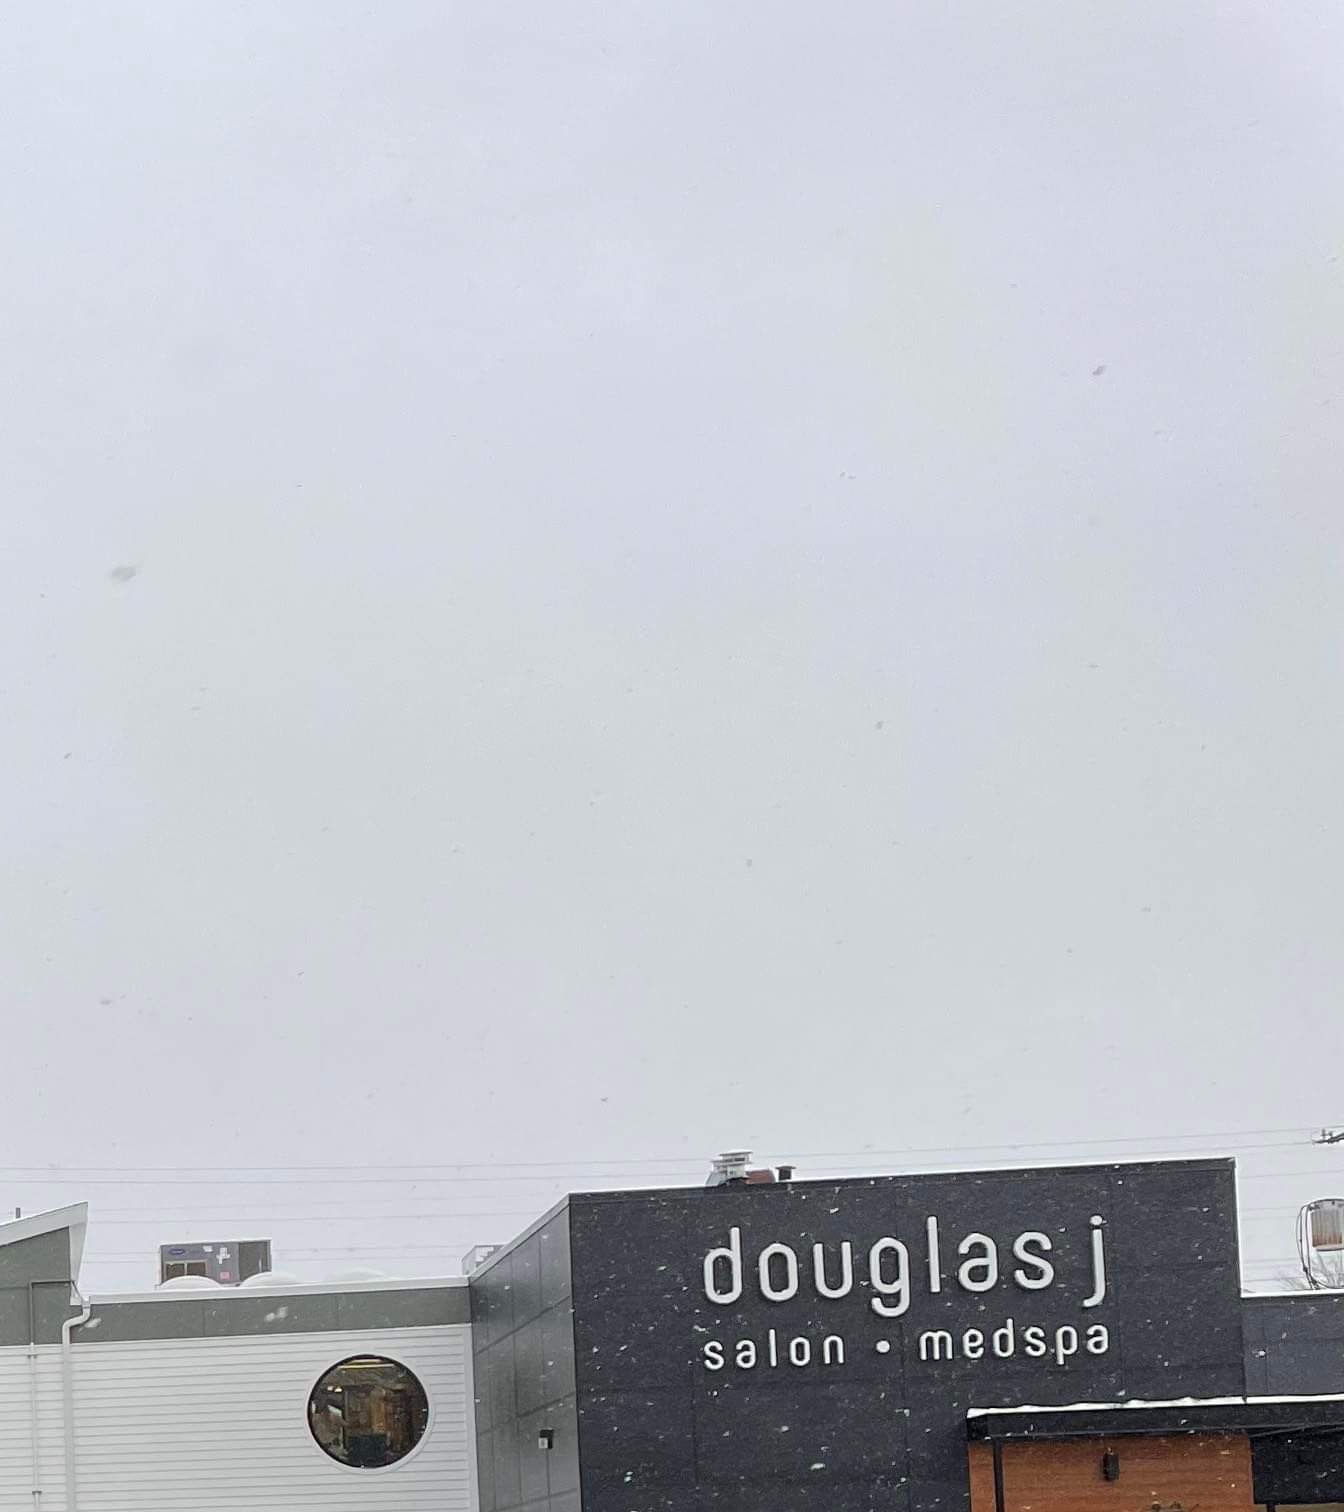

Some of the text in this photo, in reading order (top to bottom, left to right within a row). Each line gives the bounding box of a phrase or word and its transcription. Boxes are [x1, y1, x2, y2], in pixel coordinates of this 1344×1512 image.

[703, 1215, 1108, 1317] douglas j
[703, 1318, 1110, 1370] salon medspa
